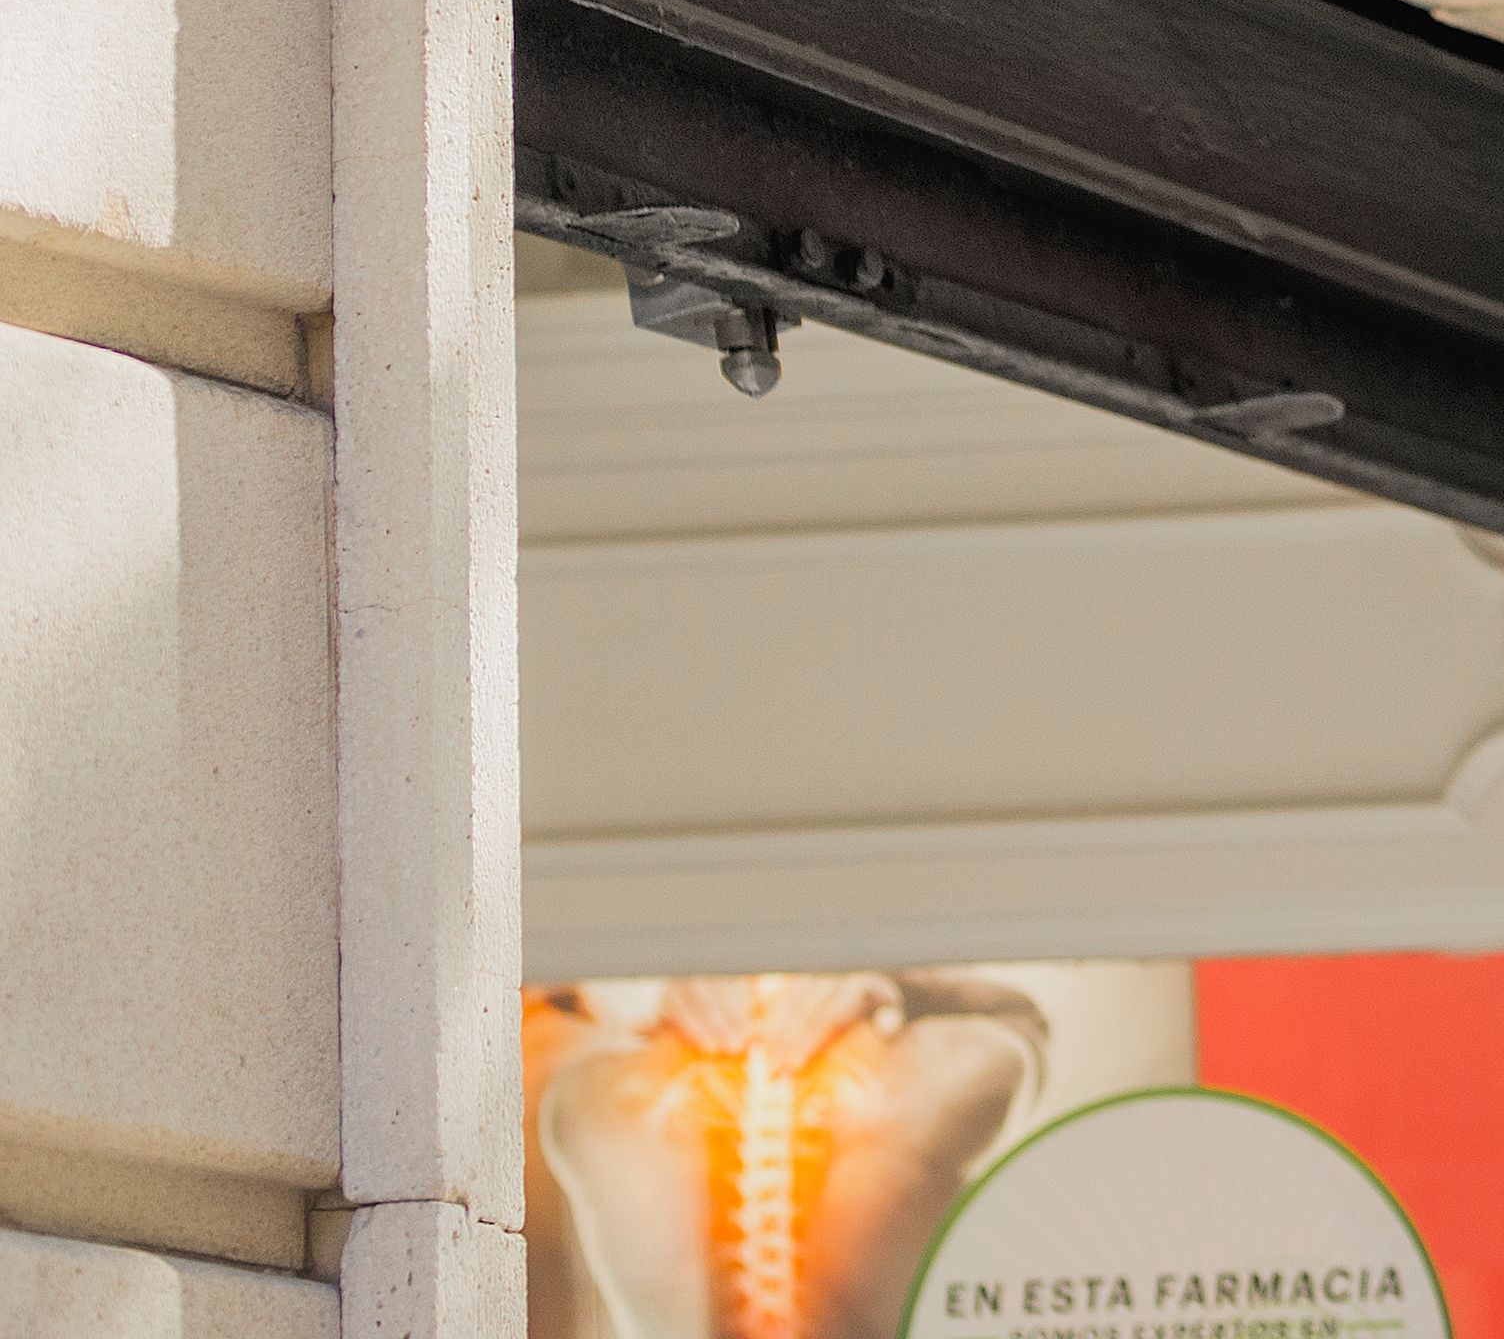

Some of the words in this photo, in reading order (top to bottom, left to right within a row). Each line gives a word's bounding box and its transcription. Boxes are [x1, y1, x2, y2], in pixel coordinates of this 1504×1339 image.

[945, 1282, 1003, 1318] EN
[1022, 1276, 1135, 1315] ESTA
[1154, 1266, 1403, 1310] FARMACIA
